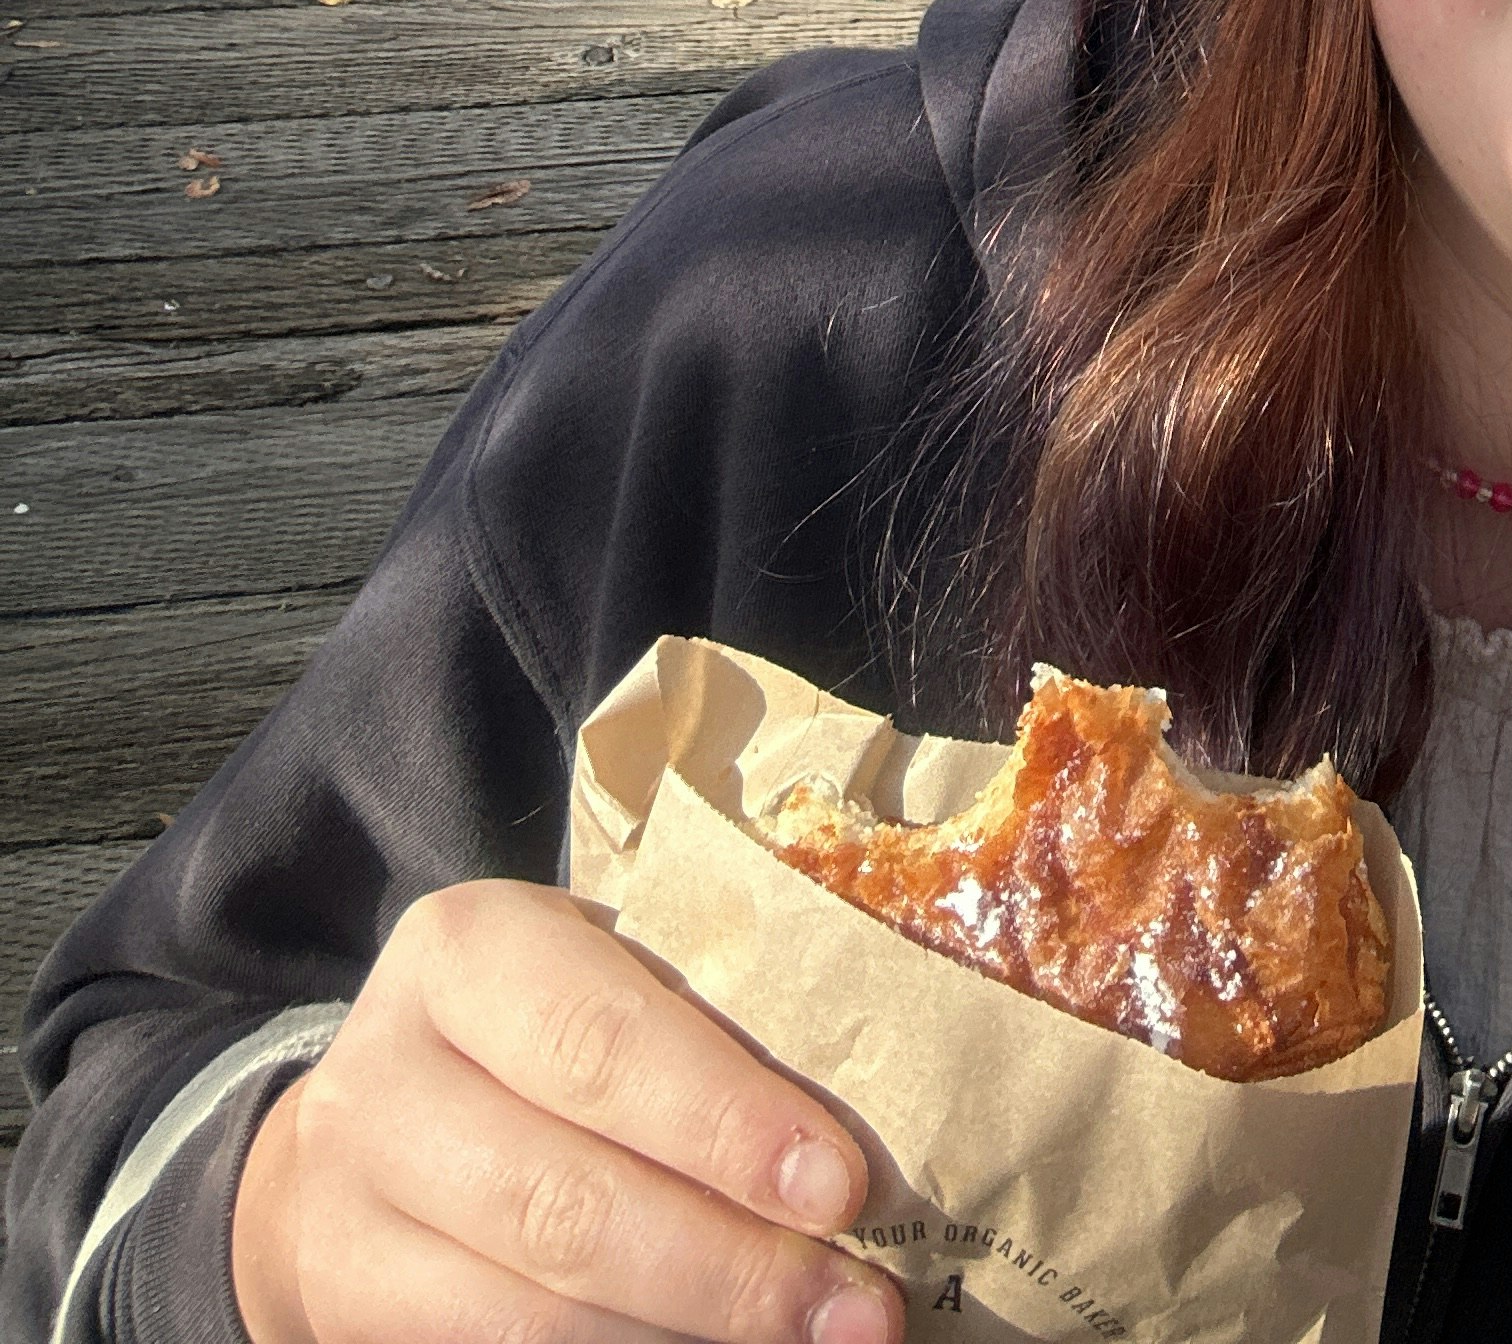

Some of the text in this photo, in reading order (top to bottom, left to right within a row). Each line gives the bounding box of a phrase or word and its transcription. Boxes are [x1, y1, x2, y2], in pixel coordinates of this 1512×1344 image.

[853, 1220, 927, 1250] YOUR
[944, 1223, 1058, 1287] ORGANIC
[932, 1274, 964, 1313] A
